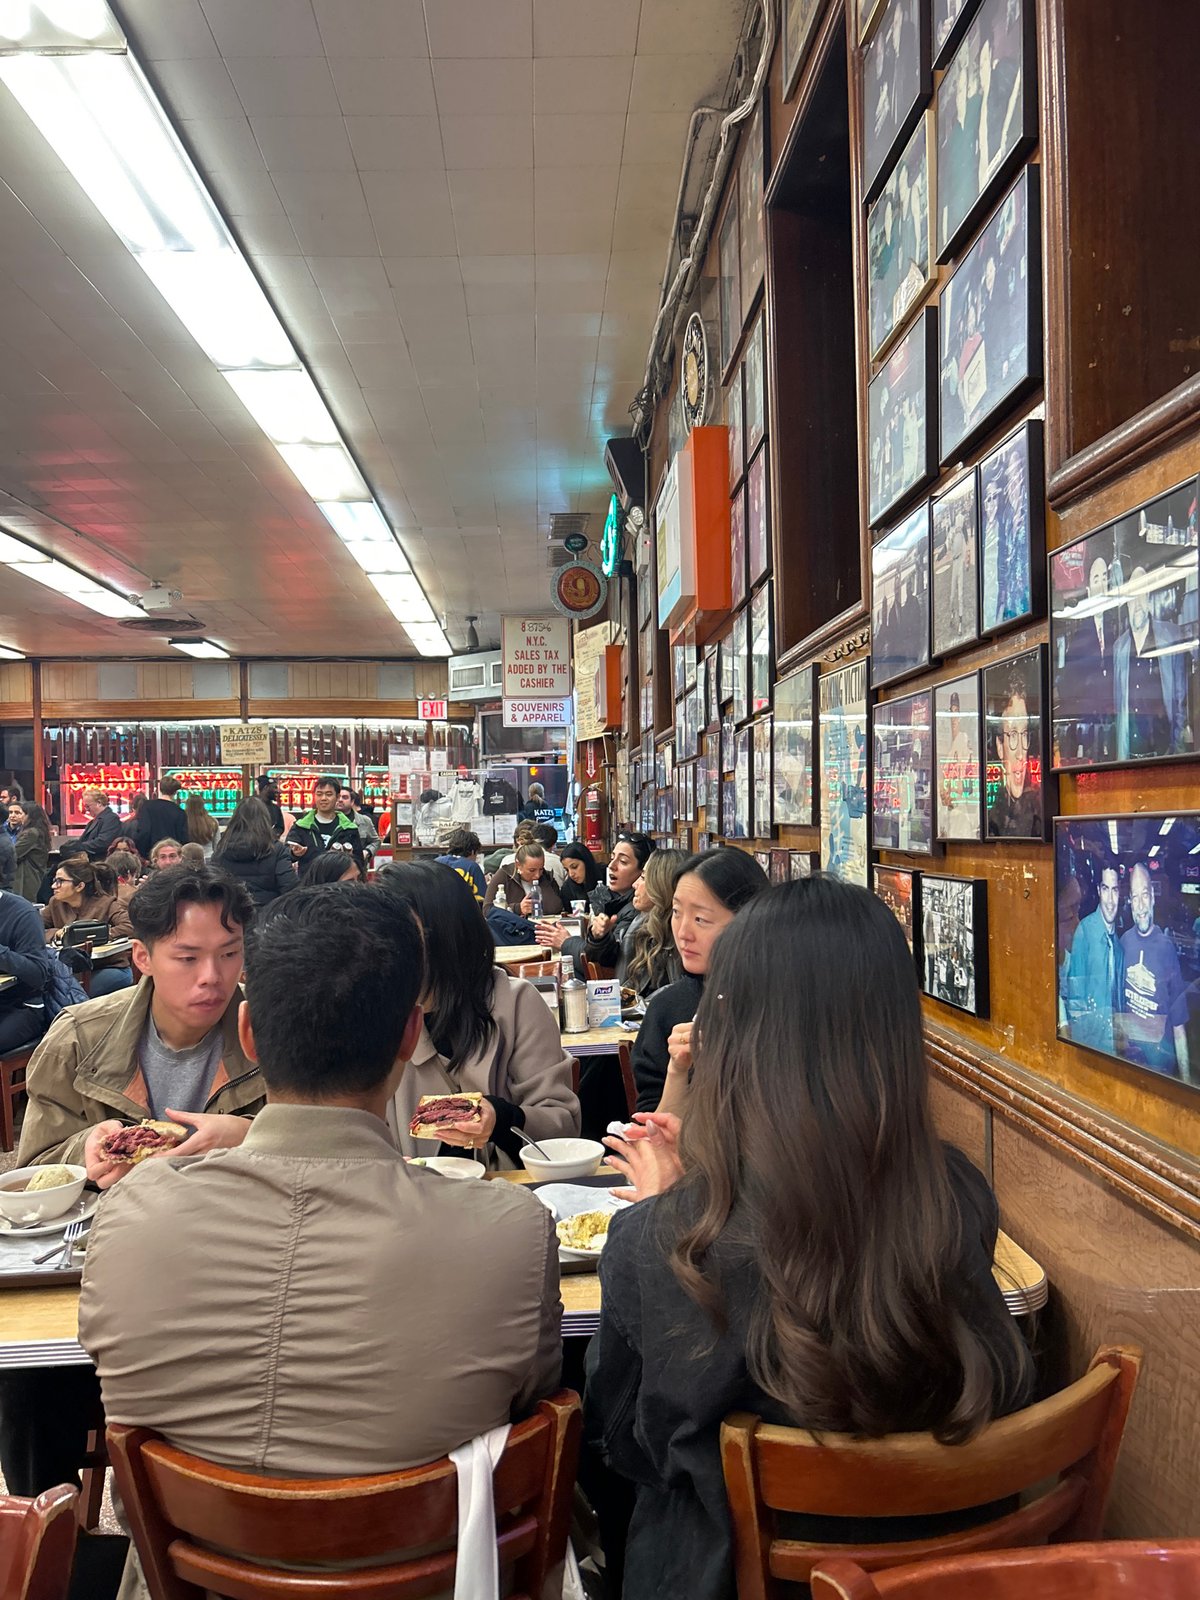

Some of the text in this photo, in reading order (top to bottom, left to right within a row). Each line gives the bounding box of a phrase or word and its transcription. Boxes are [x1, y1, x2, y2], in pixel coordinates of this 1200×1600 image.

[526, 636, 548, 646] N.Y.C.
[515, 650, 559, 660] SALES TAX
[507, 664, 567, 674] ADDED BY THE
[520, 678, 555, 688] CASHIER
[422, 701, 444, 718] EXIT
[511, 703, 565, 712] SOUVENIRS
[511, 713, 565, 722] & APPAREL
